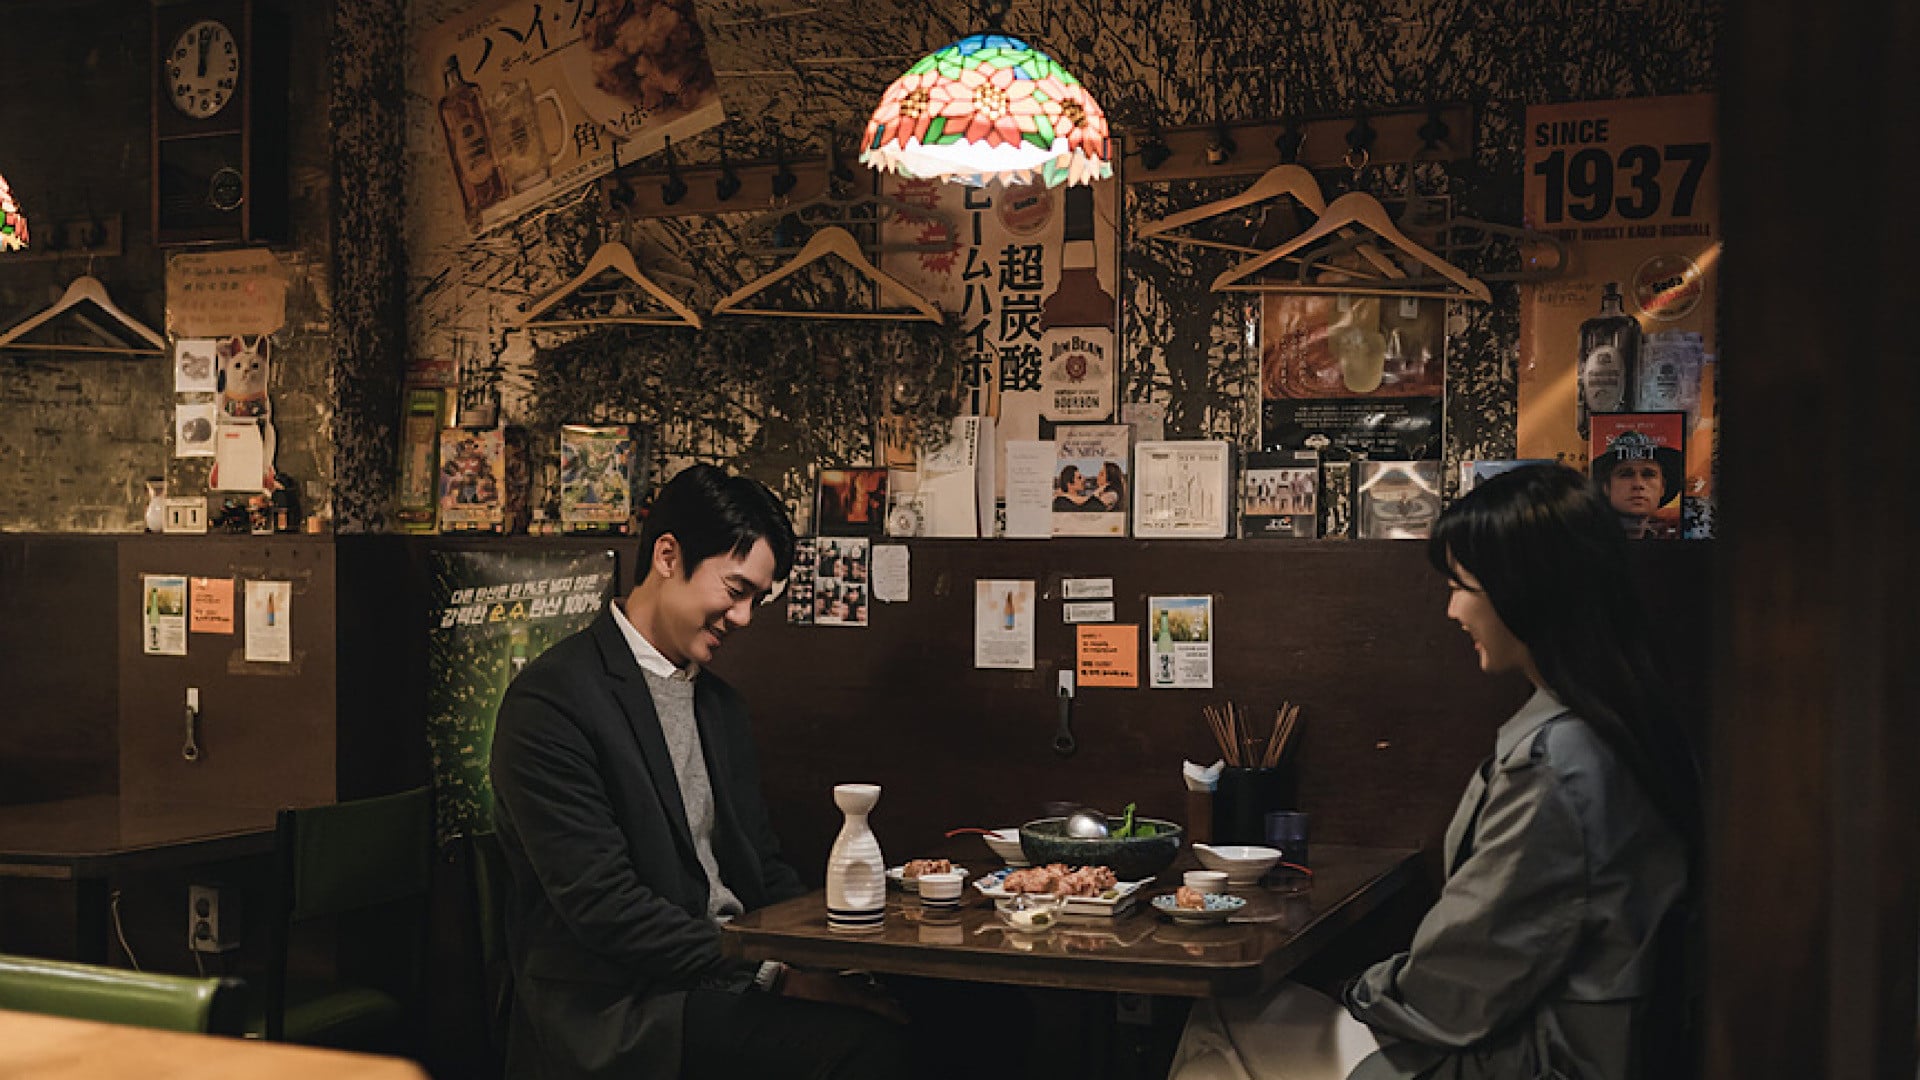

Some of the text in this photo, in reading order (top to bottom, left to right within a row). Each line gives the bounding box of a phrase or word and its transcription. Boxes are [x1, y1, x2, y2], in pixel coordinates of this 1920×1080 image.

[1535, 119, 1608, 147] SINCE
[1534, 143, 1711, 223] 1937
[999, 243, 1043, 392] 超炭酸
[1072, 336, 1104, 361] BEAM
[1054, 396, 1099, 408] BOURBON
